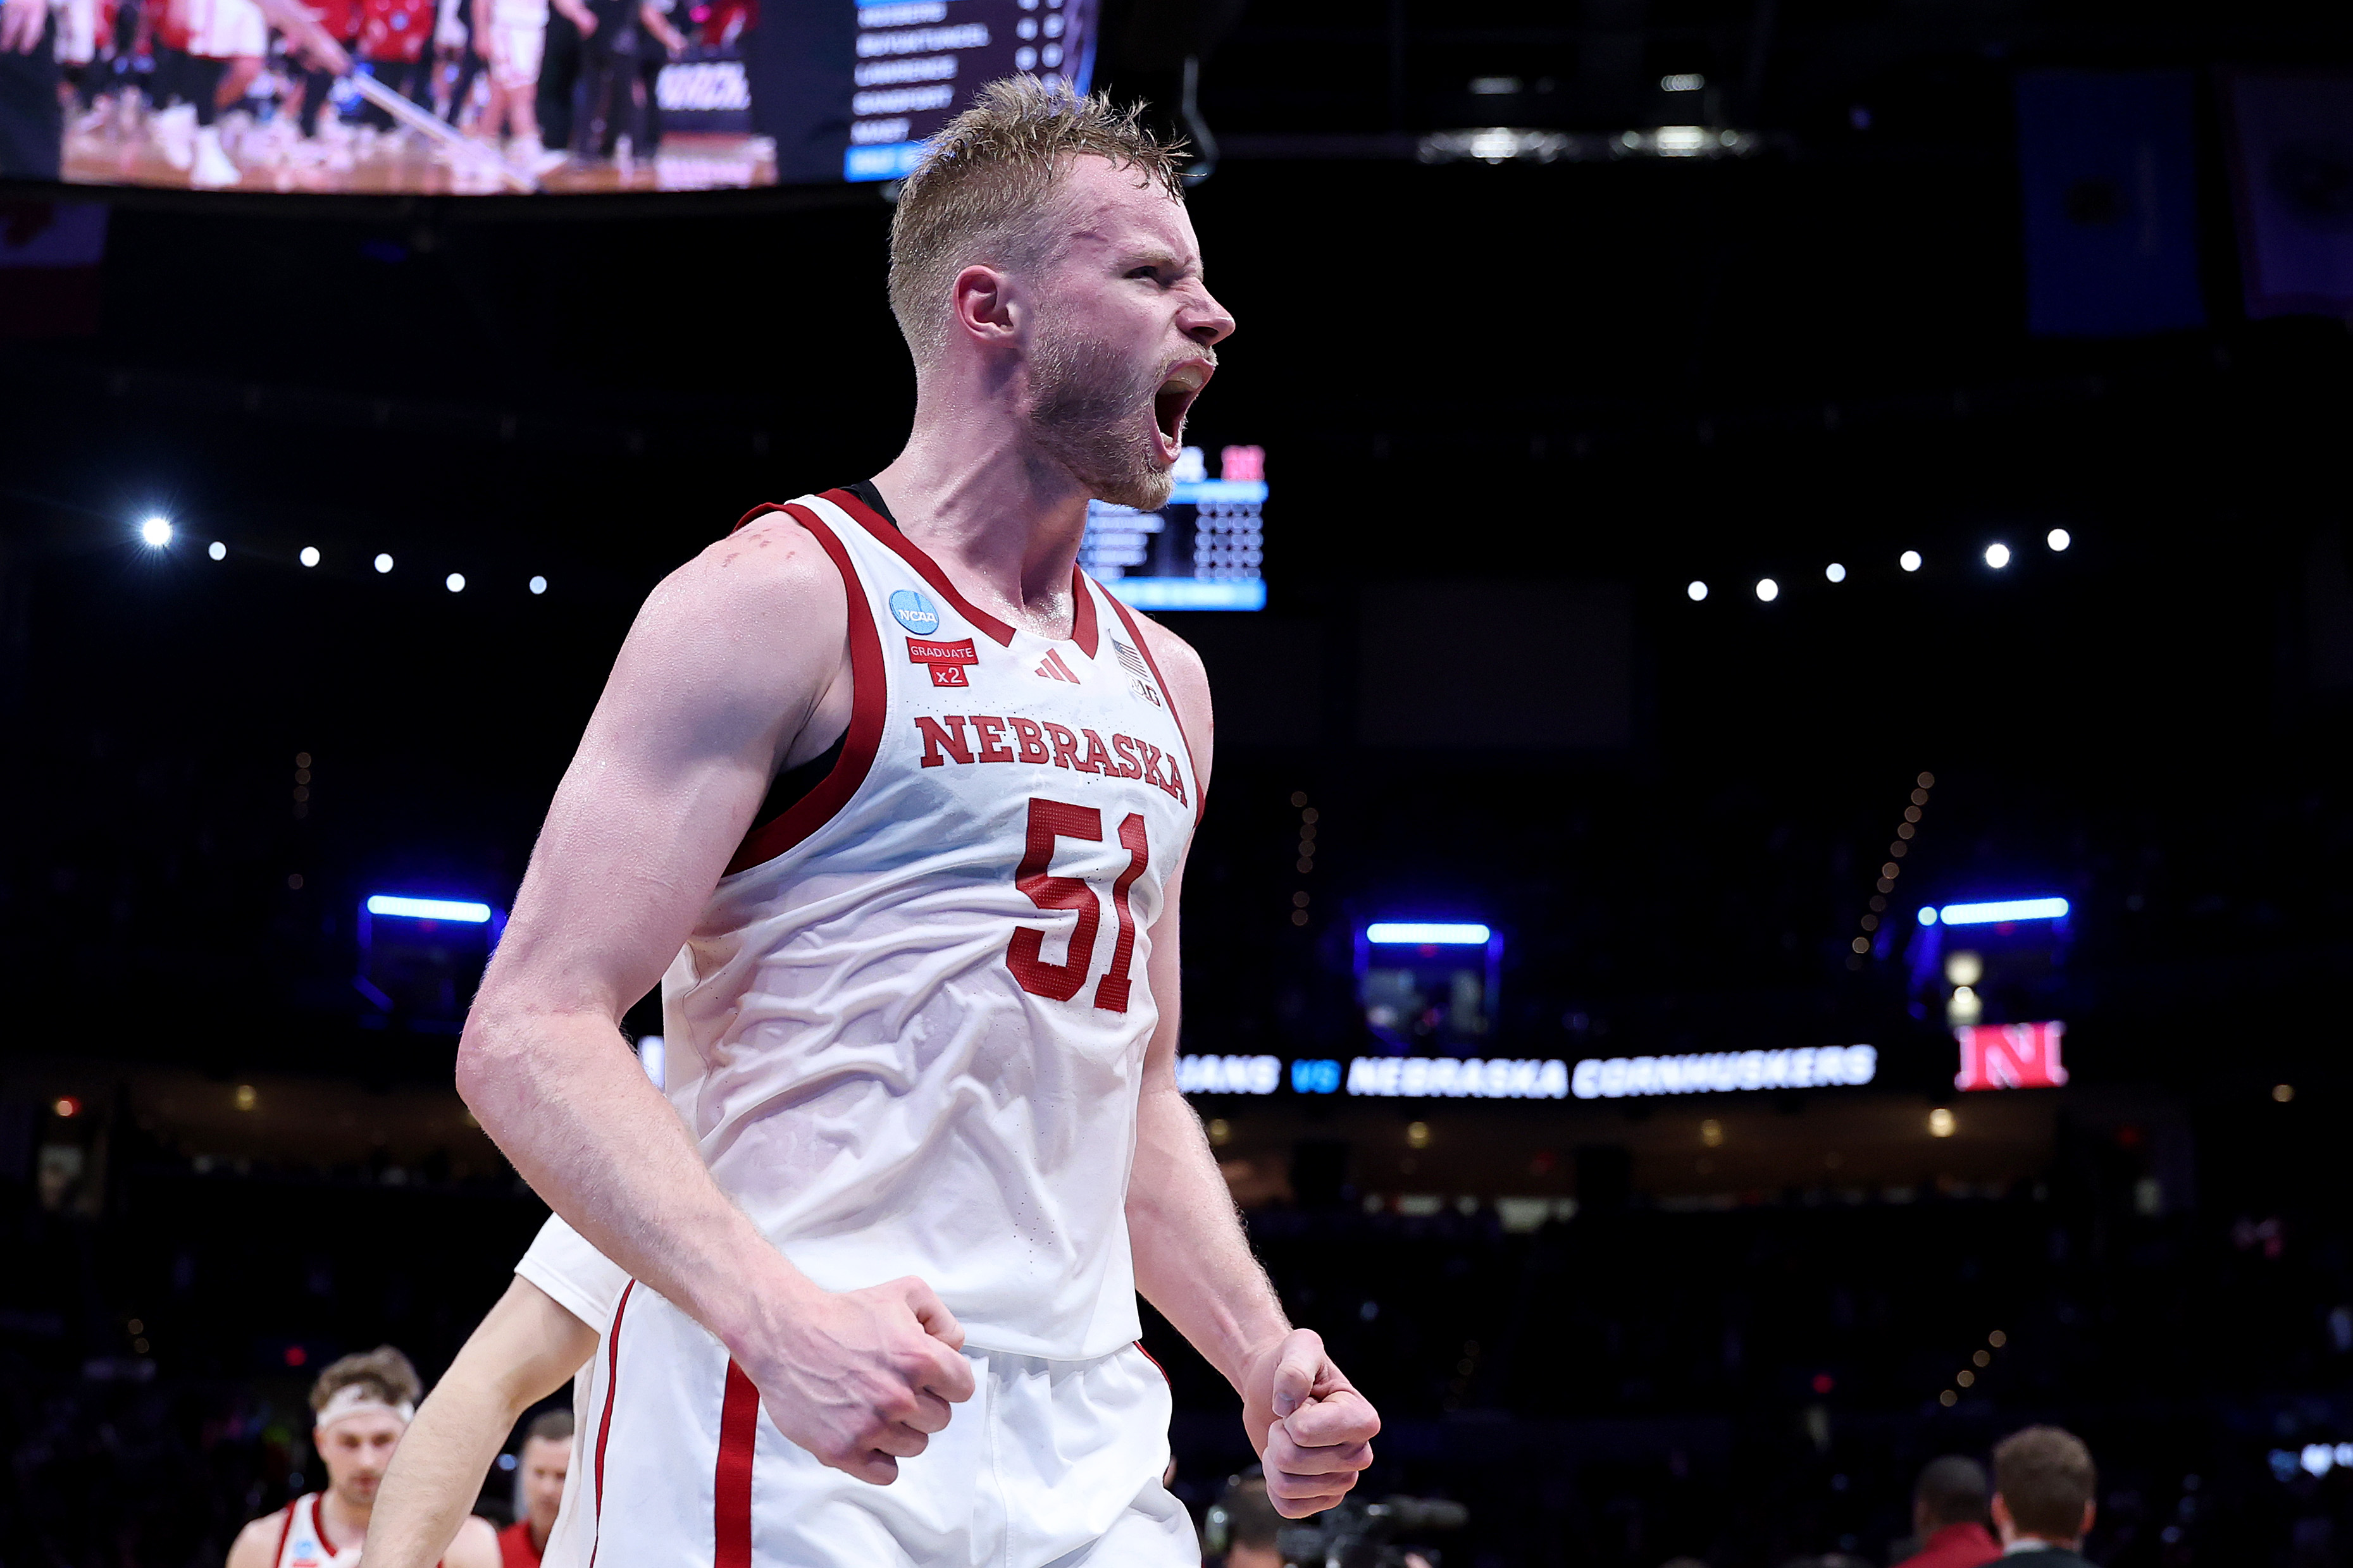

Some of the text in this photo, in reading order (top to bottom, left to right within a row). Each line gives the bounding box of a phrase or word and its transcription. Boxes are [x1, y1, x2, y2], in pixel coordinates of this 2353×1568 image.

[898, 608, 938, 624] NCAA
[910, 646, 974, 658] GRADUATE
[935, 667, 963, 683] x2
[914, 715, 1188, 809] NEBRASKA
[1005, 796, 1149, 1013] 51
[1346, 1056, 1568, 1099] NEBRASKA
[1571, 1044, 1878, 1099] CORNHUSKERS
[1954, 1020, 2069, 1092] N
